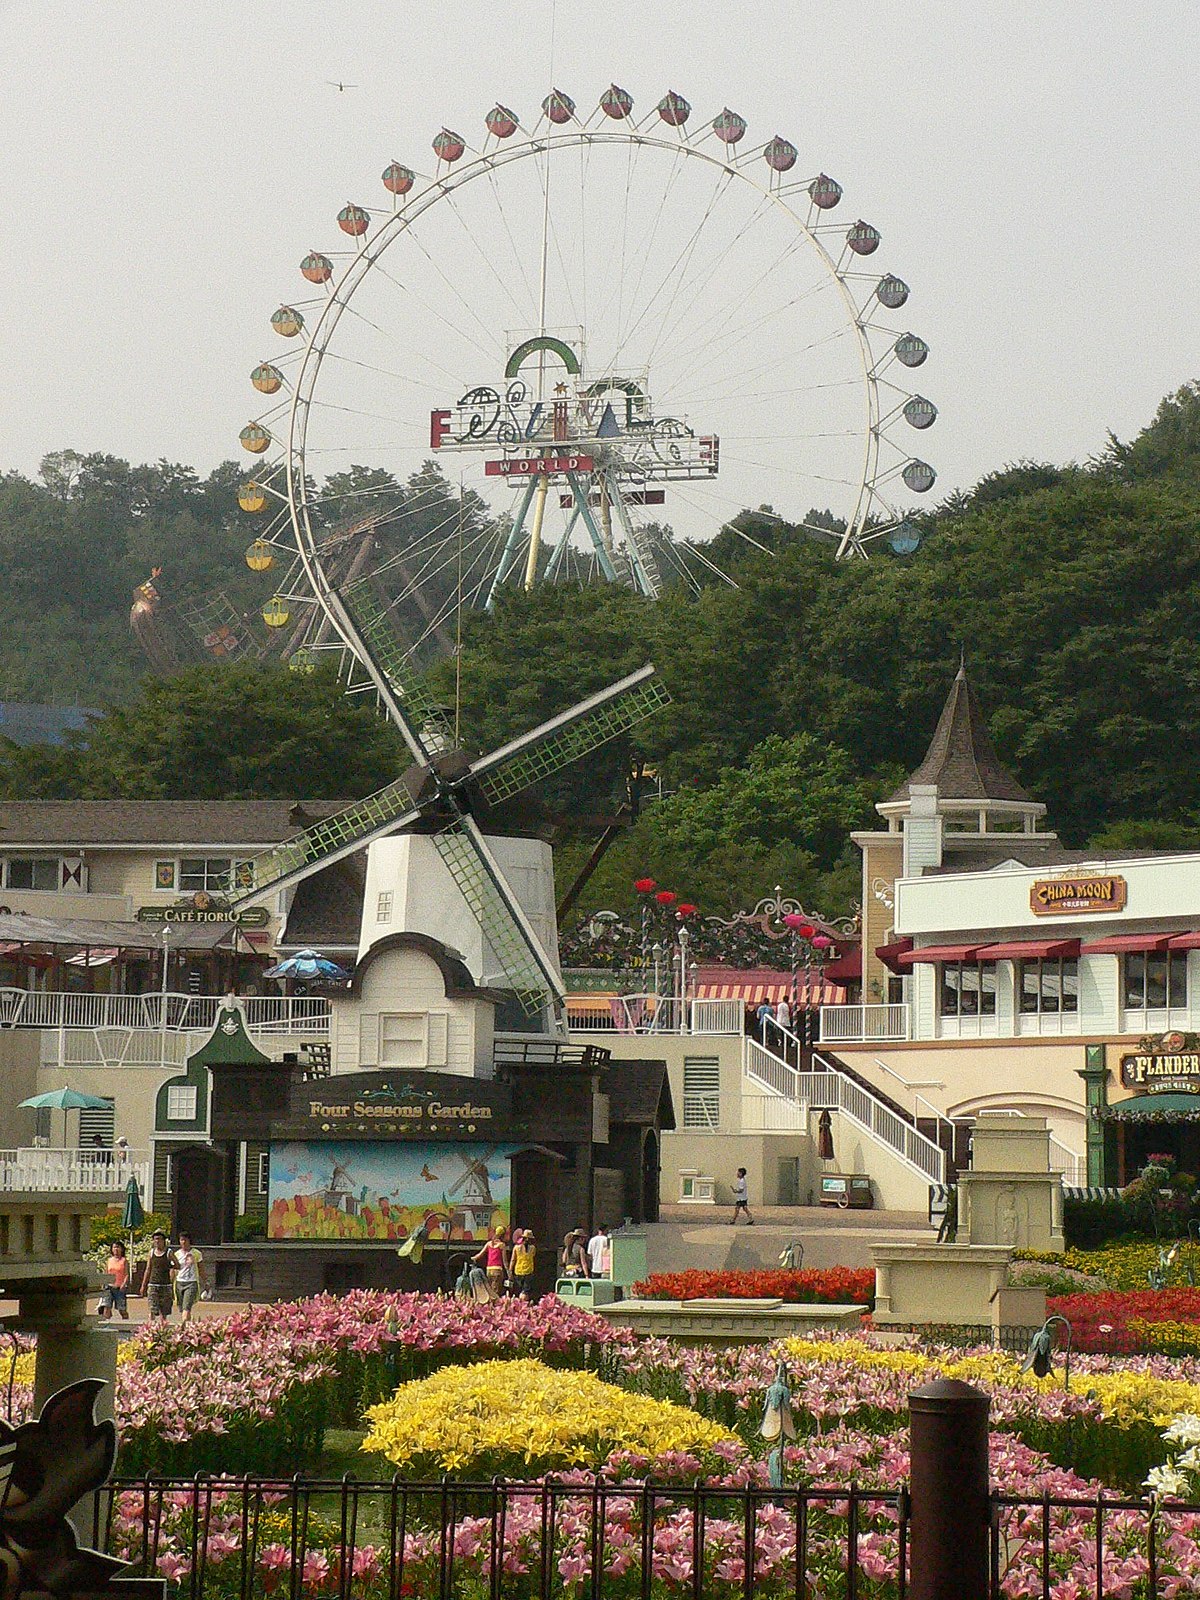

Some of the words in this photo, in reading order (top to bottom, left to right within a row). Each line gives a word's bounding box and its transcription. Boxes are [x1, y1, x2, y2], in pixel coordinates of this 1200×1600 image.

[499, 458, 579, 473] WORLD
[1036, 884, 1075, 905] CHINA
[1076, 880, 1112, 901] MOON
[197, 910, 240, 922] FIORIO
[309, 1101, 351, 1118] Four
[353, 1101, 423, 1118] Seasons
[427, 1102, 492, 1119] Garden
